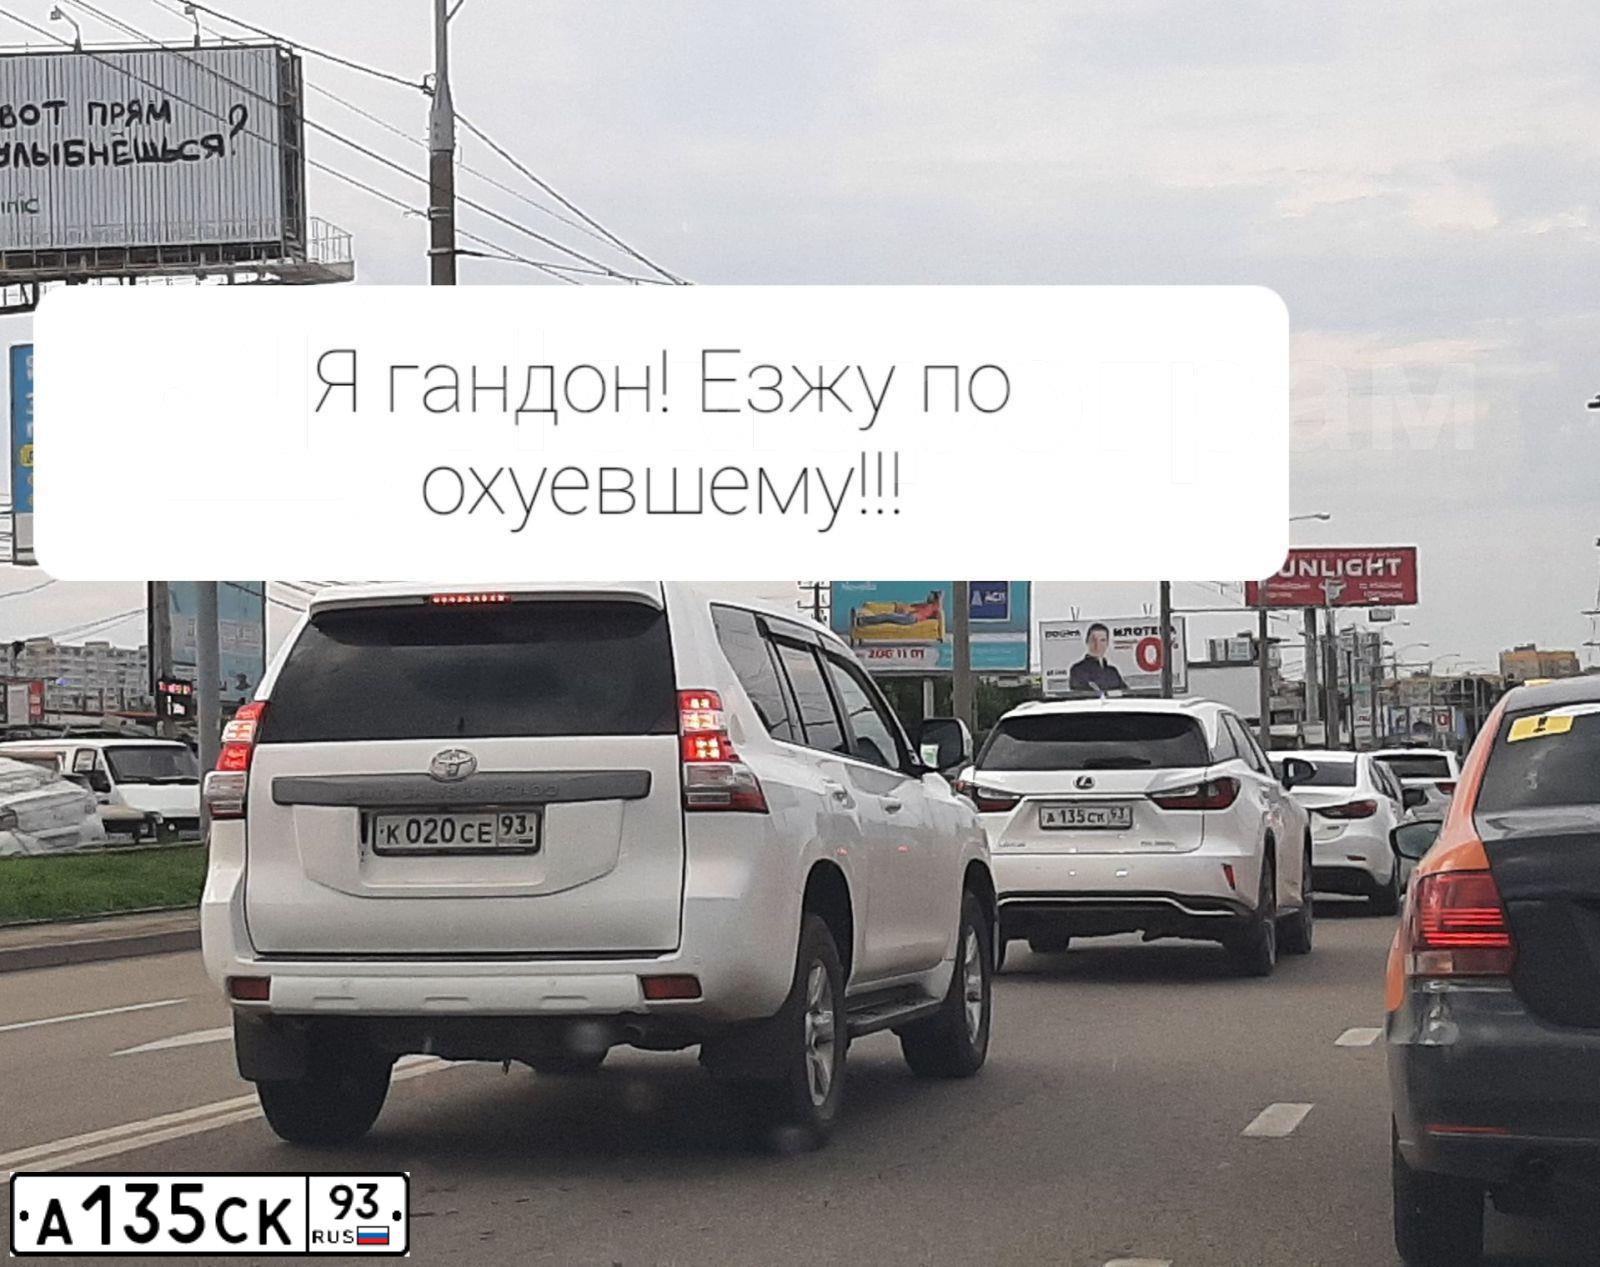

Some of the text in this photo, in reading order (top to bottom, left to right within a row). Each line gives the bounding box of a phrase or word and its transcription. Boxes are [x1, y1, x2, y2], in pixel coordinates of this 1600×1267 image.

[0, 100, 171, 129] ВОТ ПРЯМ
[1278, 558, 1402, 578] UNLIGHT
[501, 815, 526, 835] 93
